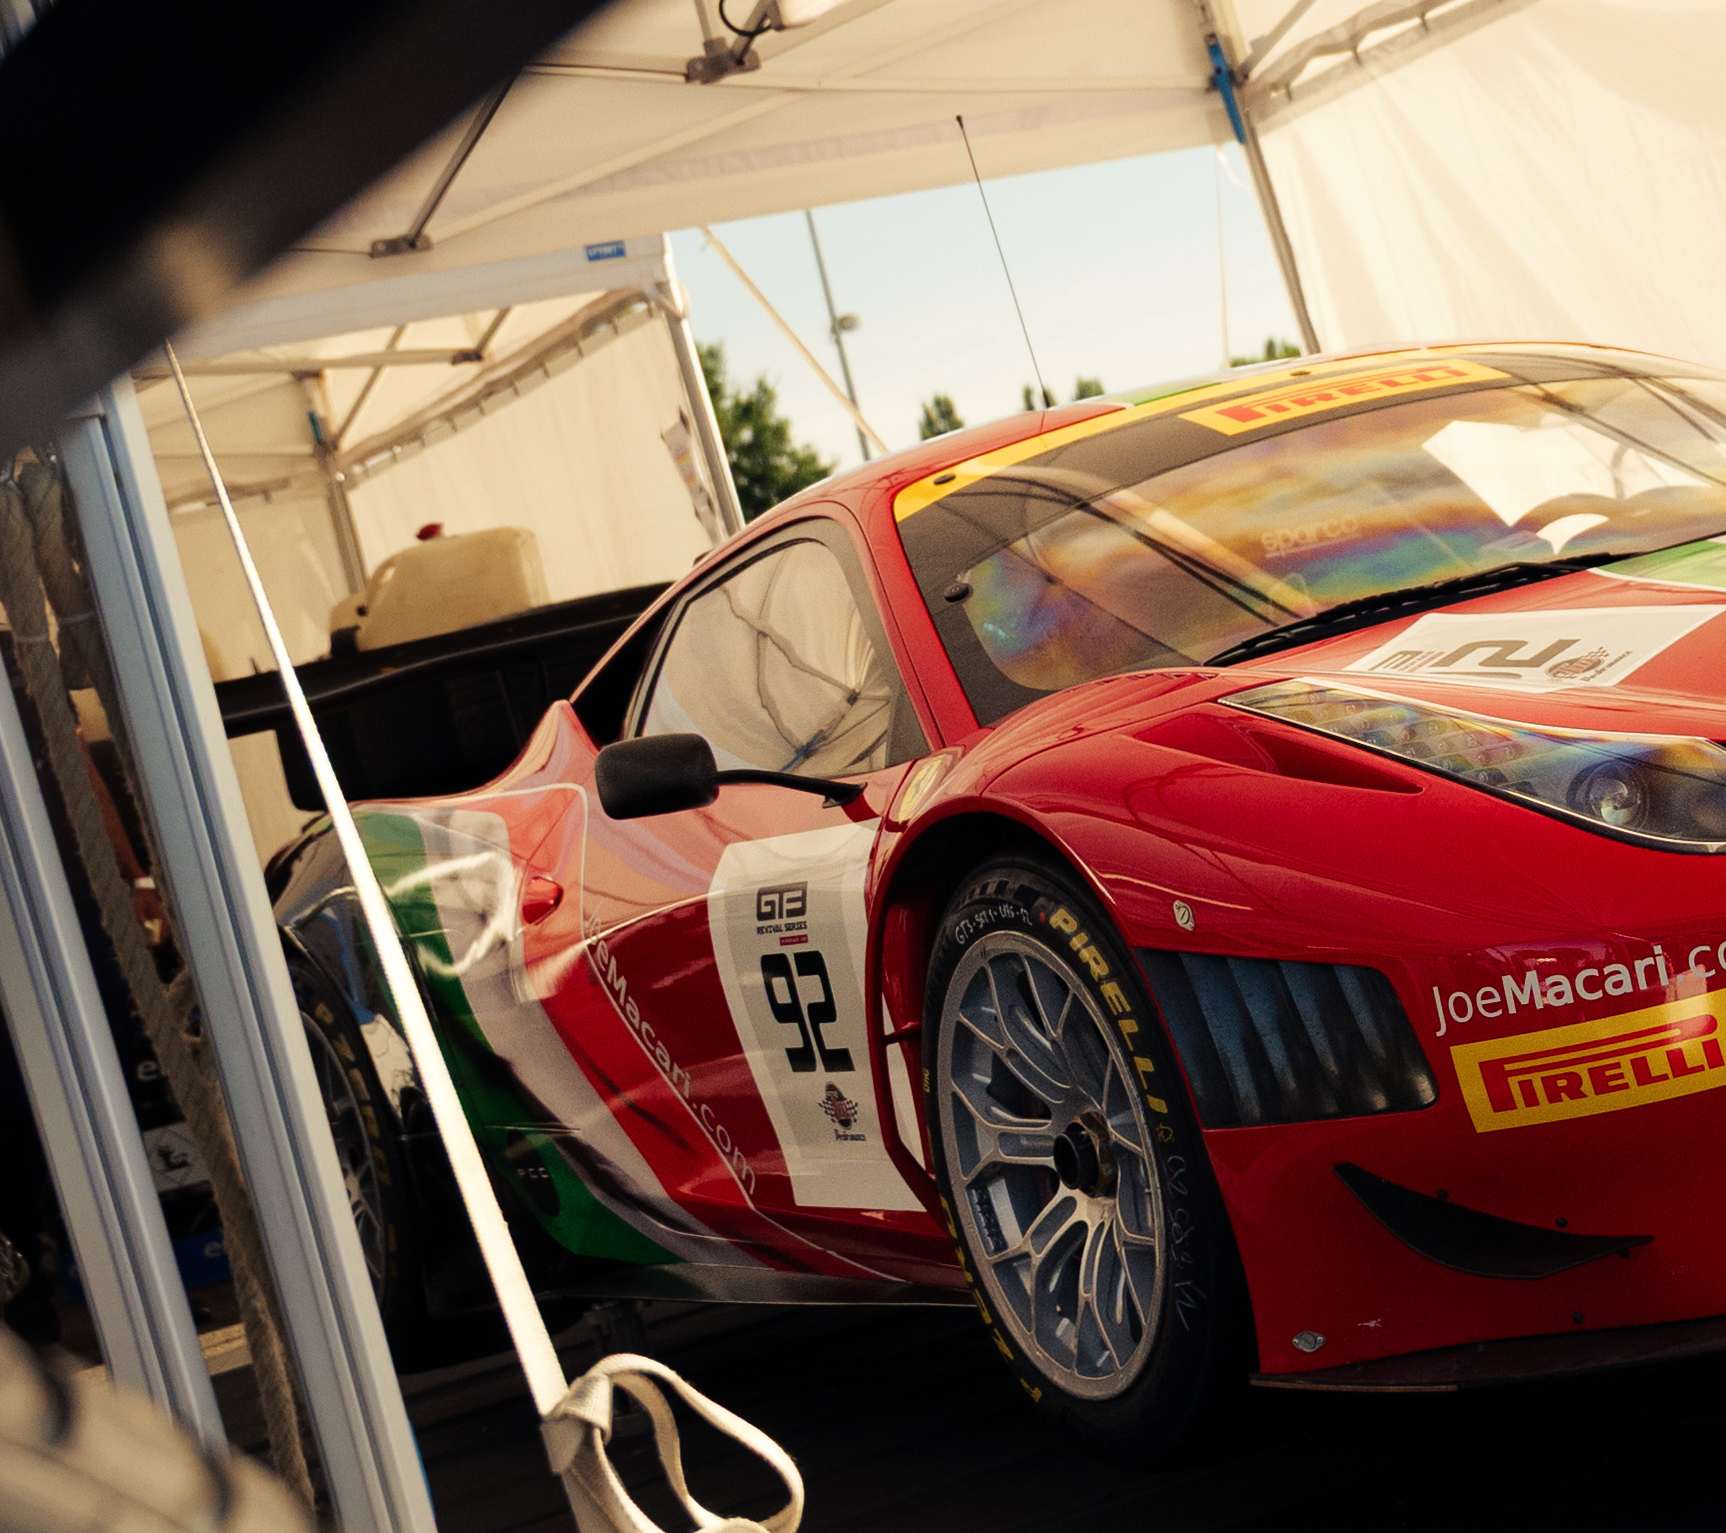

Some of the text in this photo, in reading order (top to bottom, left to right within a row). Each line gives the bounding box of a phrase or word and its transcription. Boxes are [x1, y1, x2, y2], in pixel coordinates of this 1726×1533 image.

[1215, 366, 1470, 423] PIRELLI
[1261, 515, 1360, 558] sparco
[756, 881, 808, 922] GT3
[760, 949, 856, 1073] 92
[1049, 908, 1168, 1115] PIRELLI
[1477, 1013, 1725, 1114] PIRELLI
